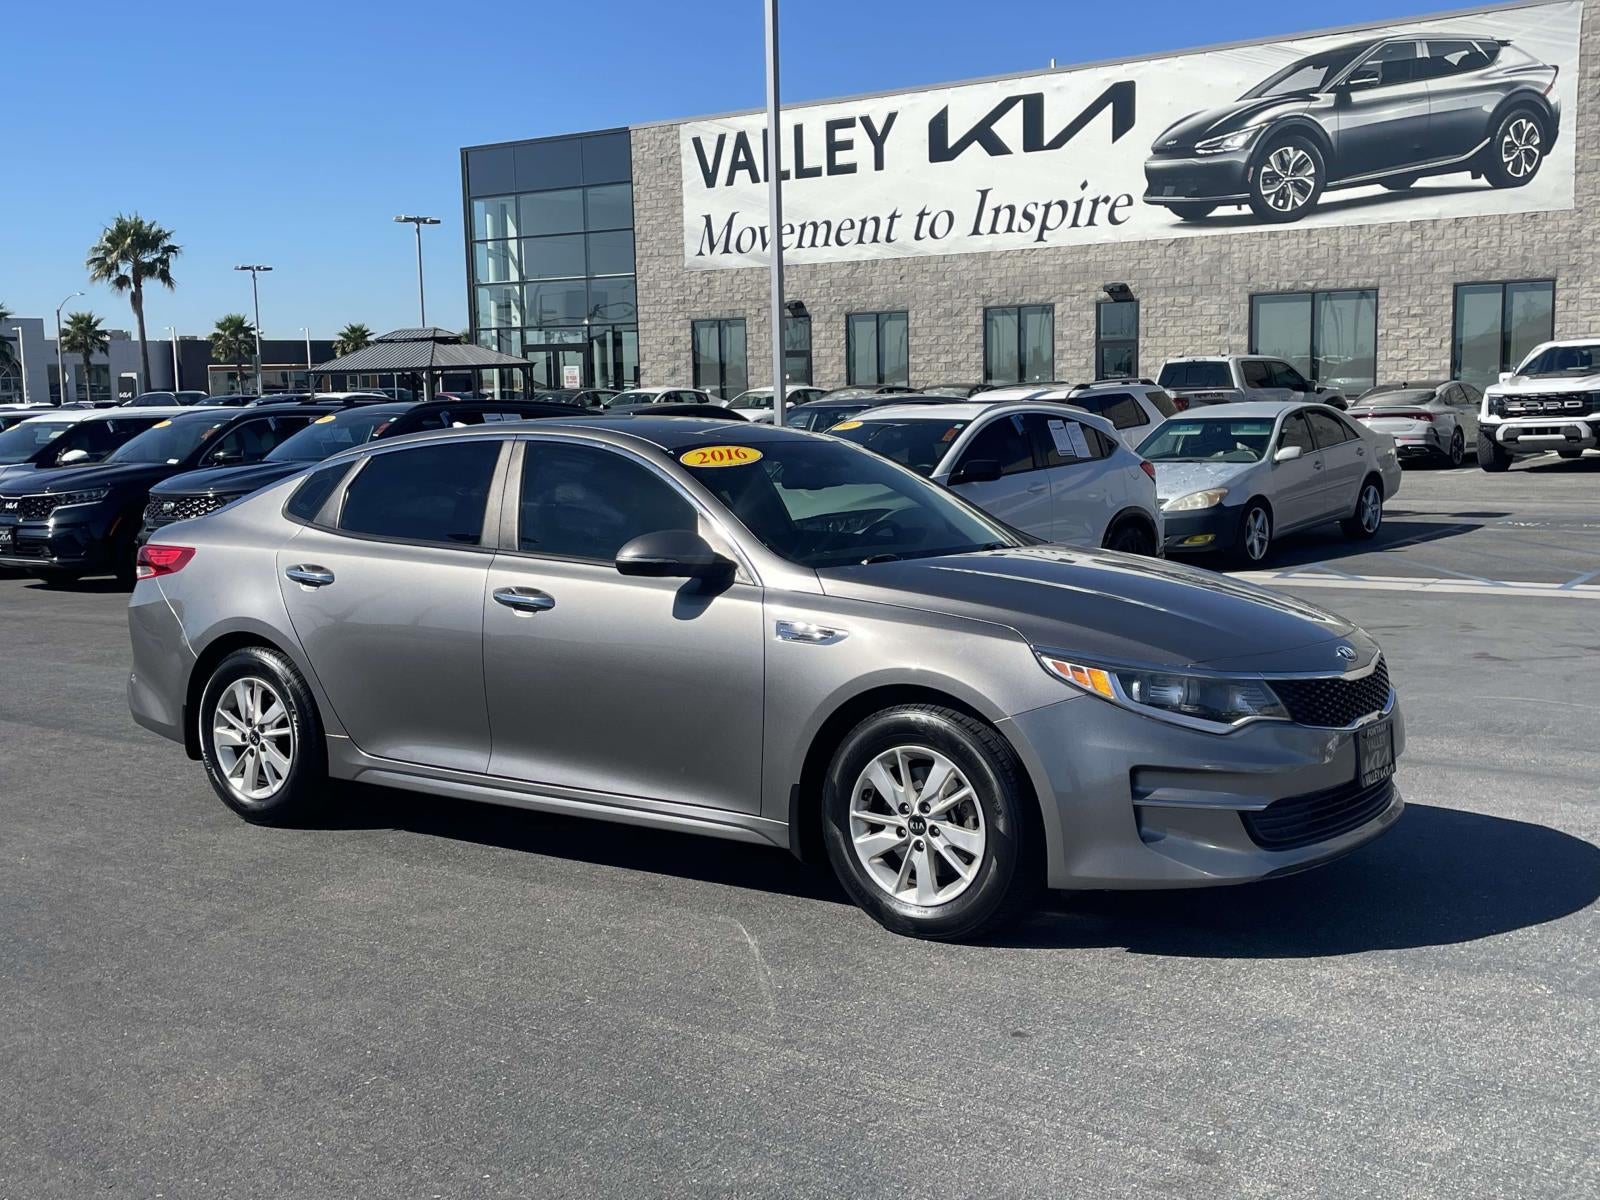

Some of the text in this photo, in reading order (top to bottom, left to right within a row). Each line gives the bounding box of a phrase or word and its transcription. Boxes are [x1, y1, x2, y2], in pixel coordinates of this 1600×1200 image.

[691, 80, 1136, 189] VALLEY KIA
[695, 179, 1134, 257] Movement to Inspire
[696, 448, 748, 464] 2016
[909, 821, 925, 830] KIA
